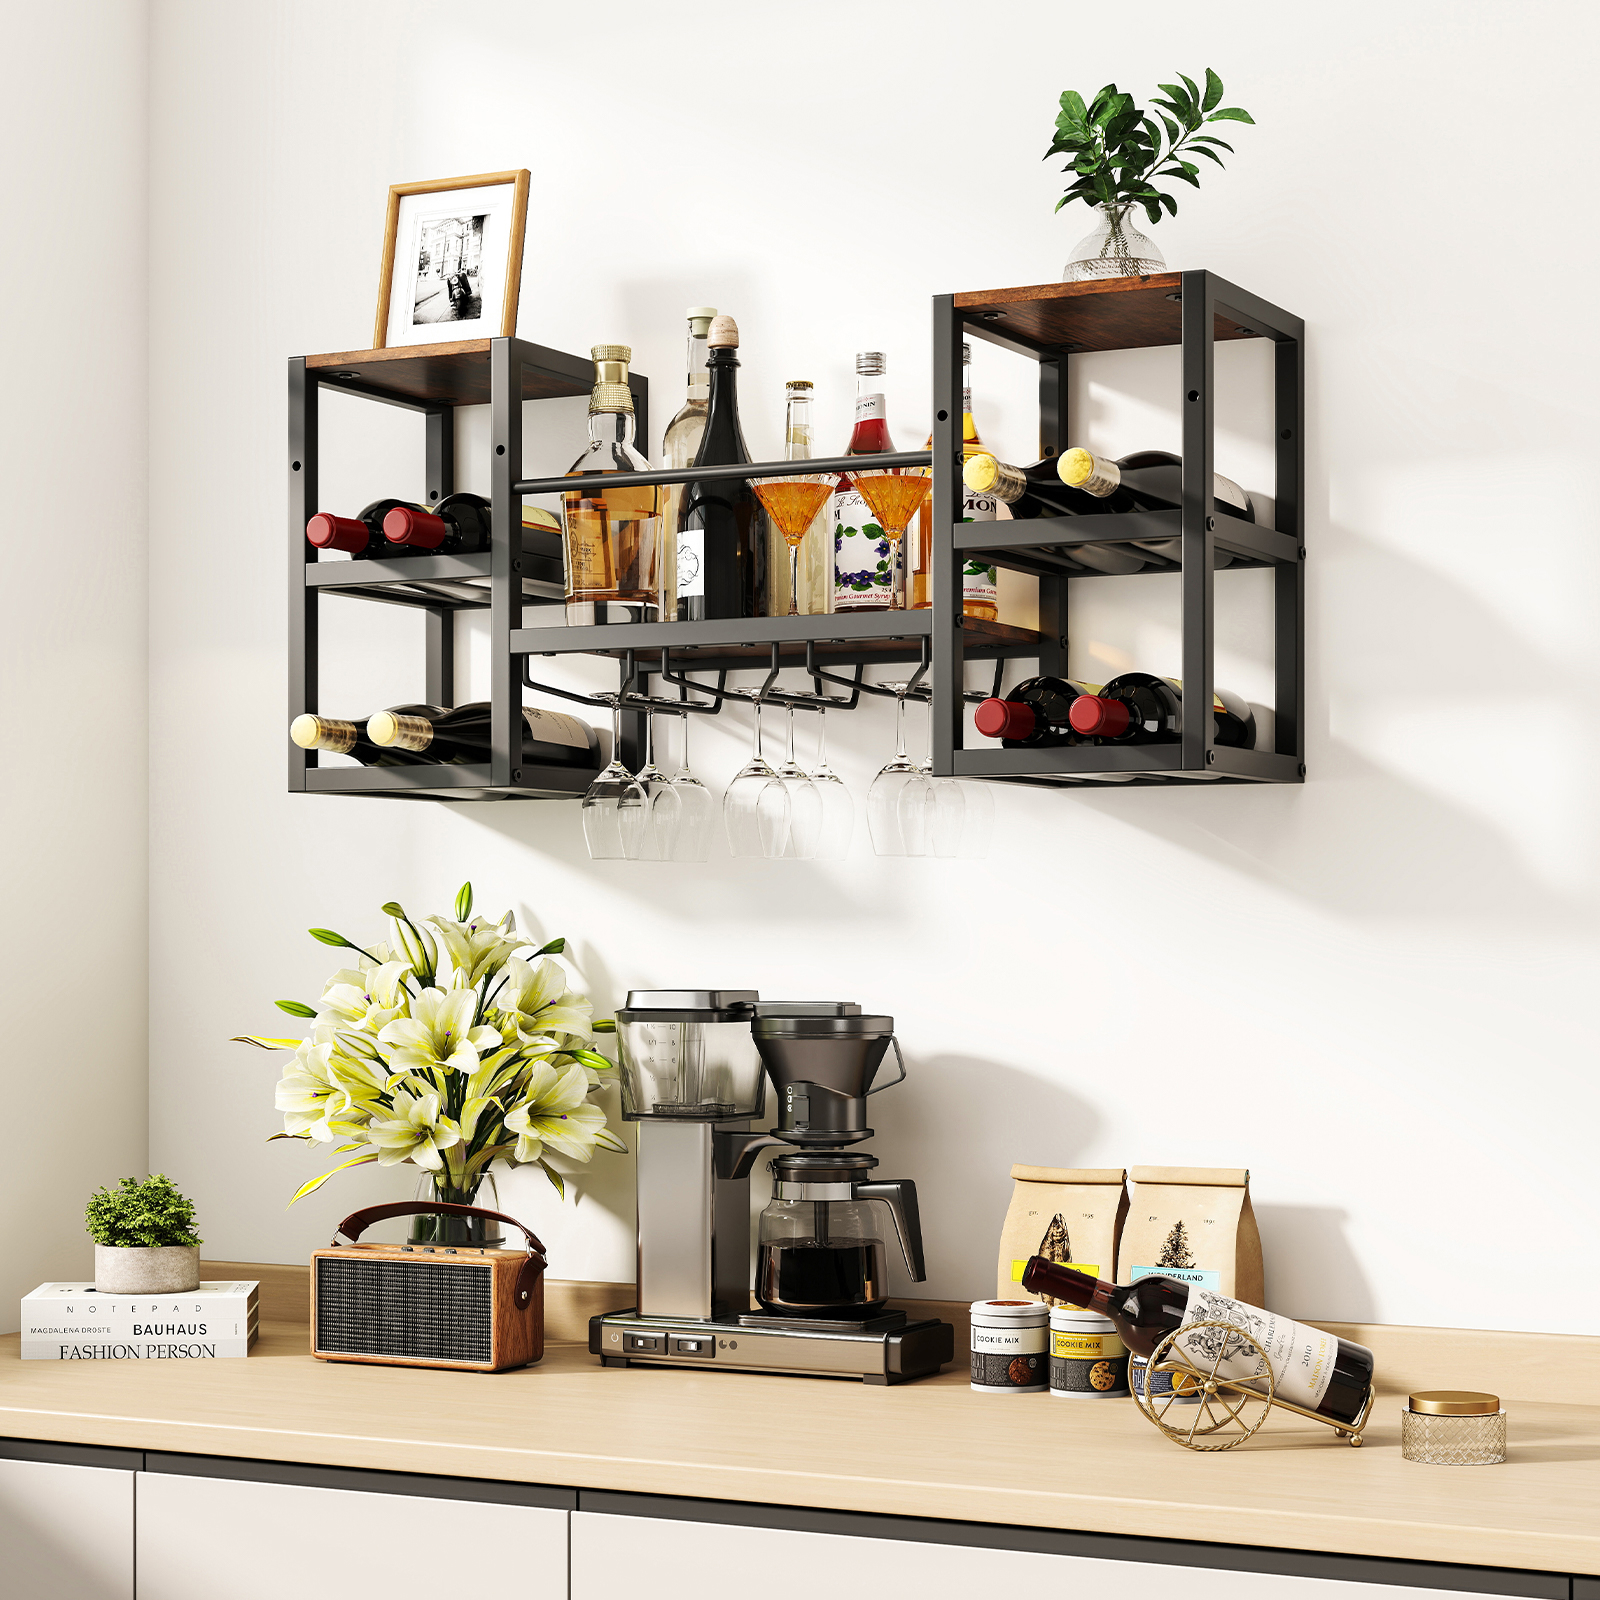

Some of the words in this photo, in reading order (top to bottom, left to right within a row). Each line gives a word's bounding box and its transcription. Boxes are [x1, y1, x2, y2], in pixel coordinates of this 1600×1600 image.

[133, 1323, 208, 1336] BAUHAUS
[976, 1335, 1003, 1344] COOKIE
[1056, 1340, 1084, 1349] COOKIE
[59, 1344, 142, 1360] FASHION
[145, 1343, 217, 1359] PERSON
[1302, 1345, 1313, 1367] 2010
[1307, 1359, 1324, 1390] MAISON
